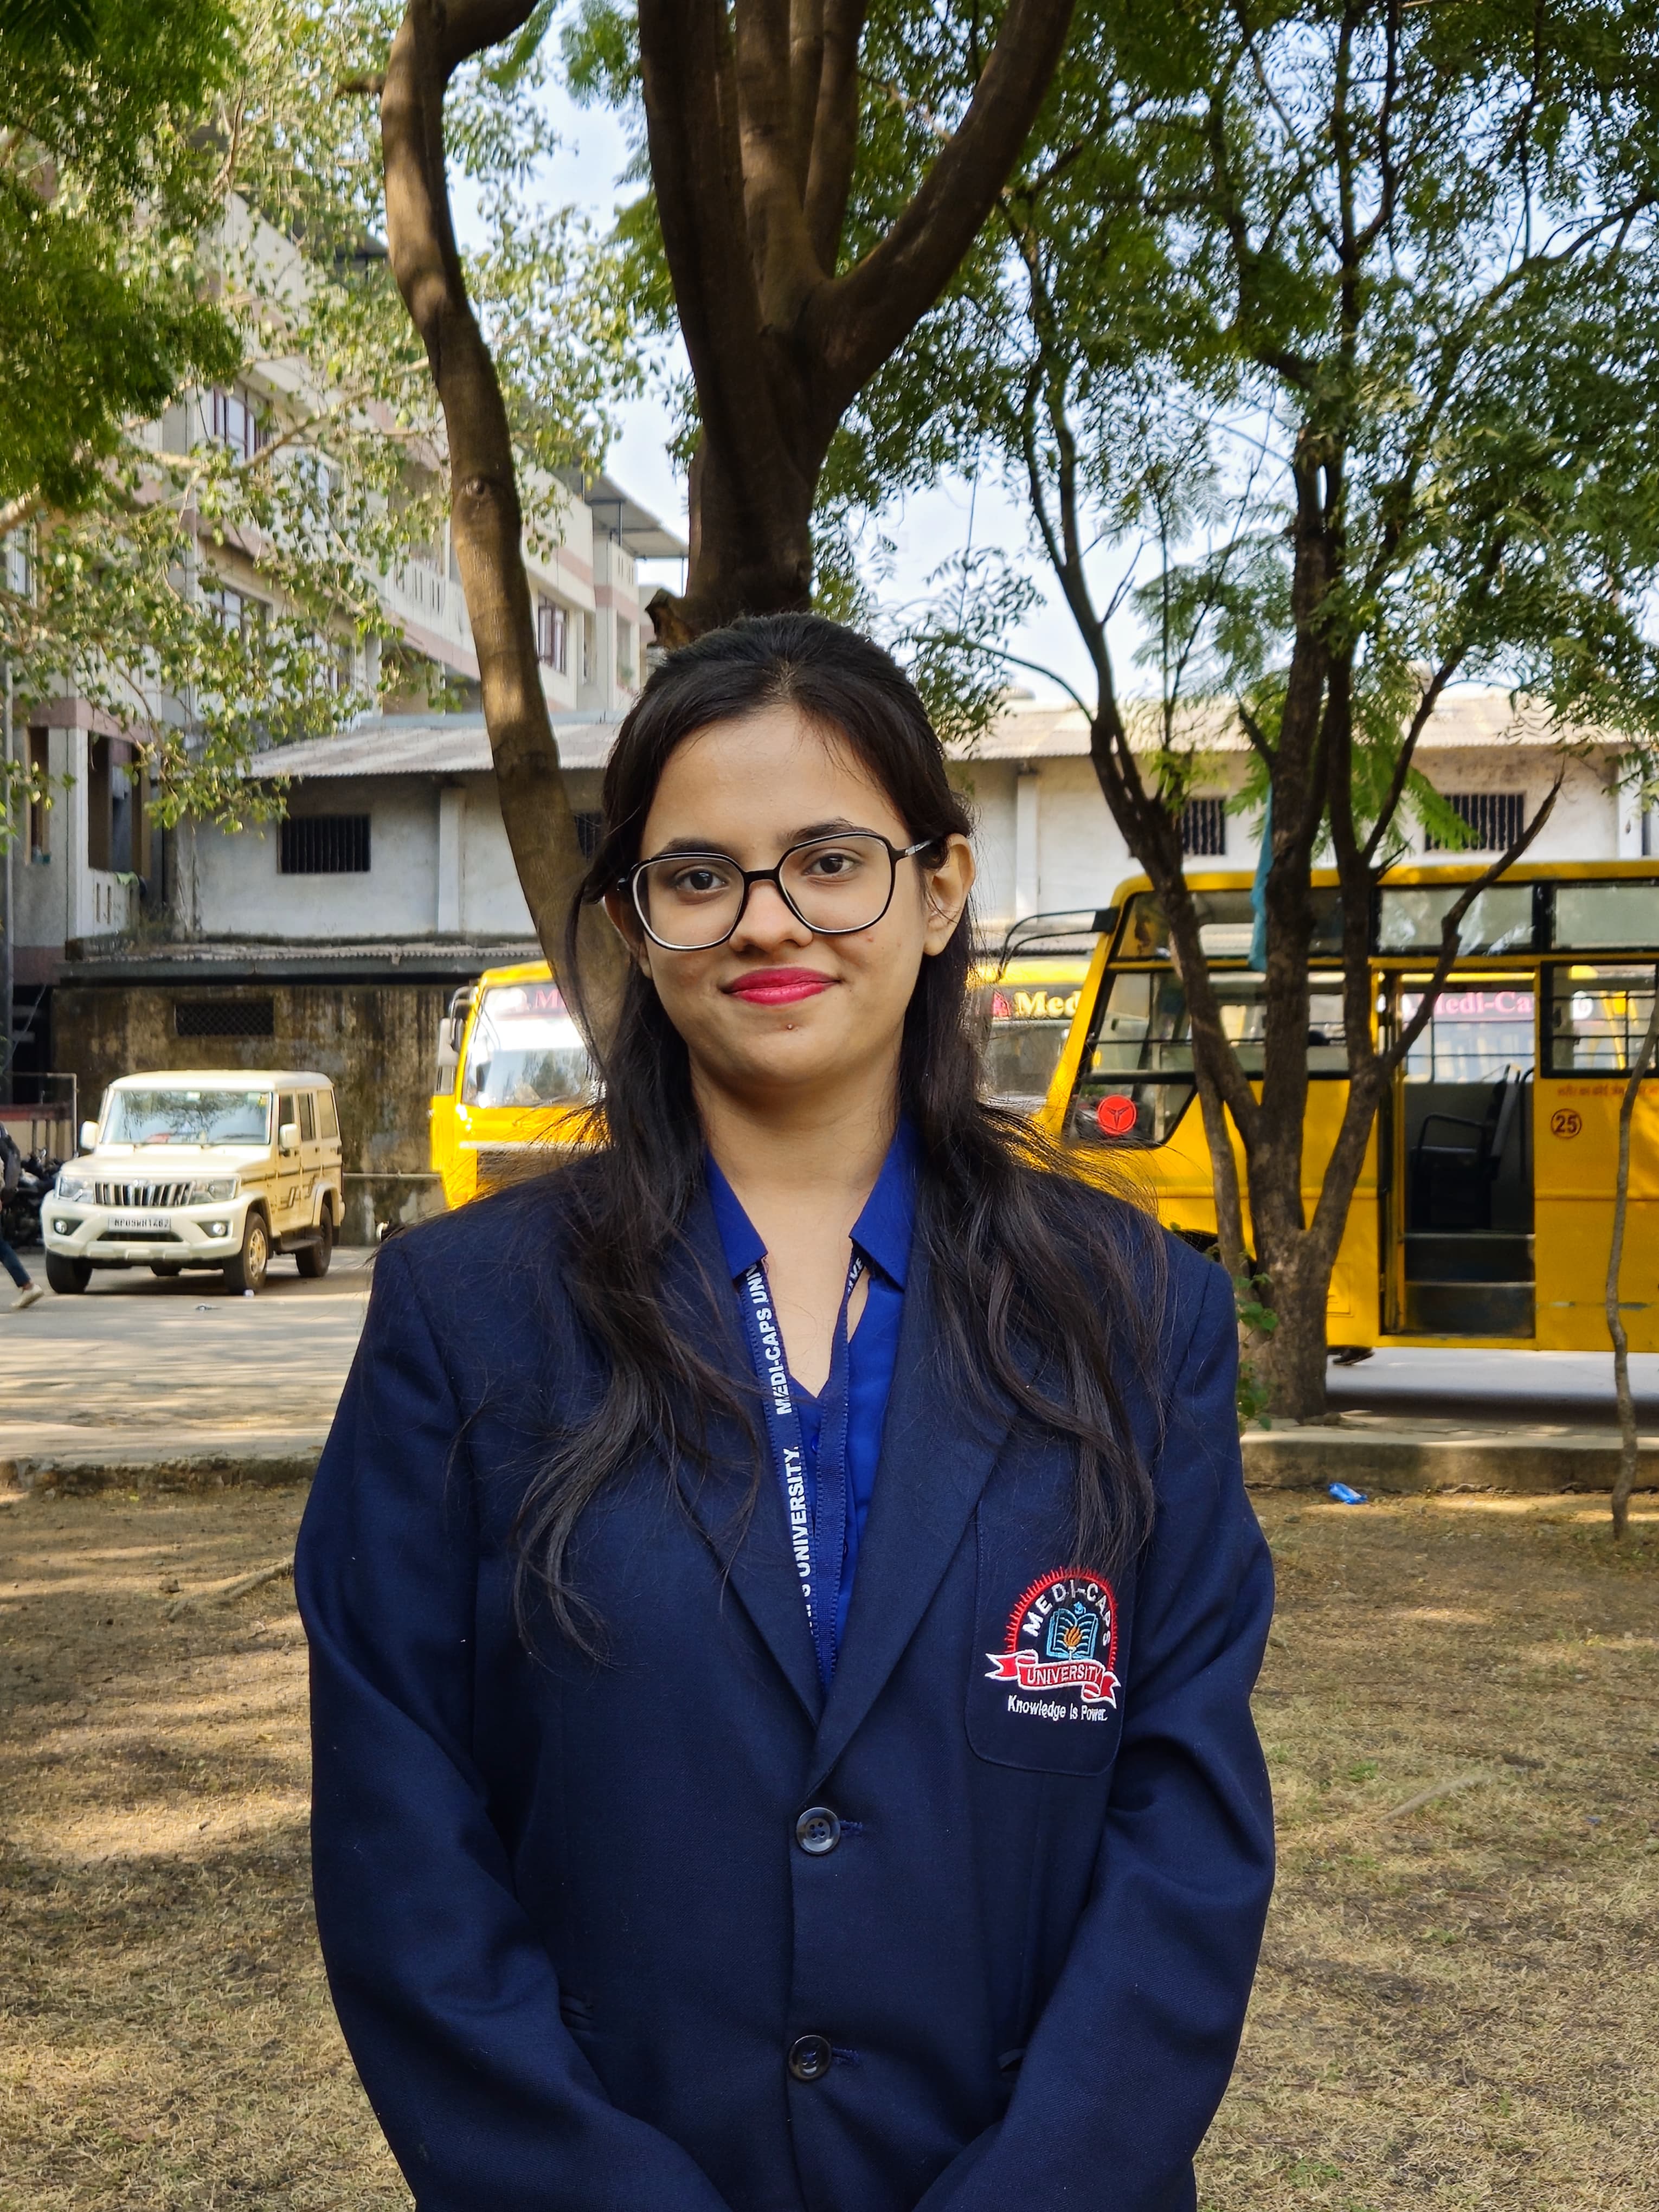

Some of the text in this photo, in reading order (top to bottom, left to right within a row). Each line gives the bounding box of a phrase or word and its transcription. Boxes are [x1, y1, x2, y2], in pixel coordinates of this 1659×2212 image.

[1555, 1114, 1578, 1133] 25
[756, 1307, 792, 1415] MEDI-CAPS
[1022, 1579, 1110, 1647] MEDI-CAPS
[1027, 1664, 1103, 1685] UNIVERSITY
[1007, 1694, 1066, 1721] Knowledge
